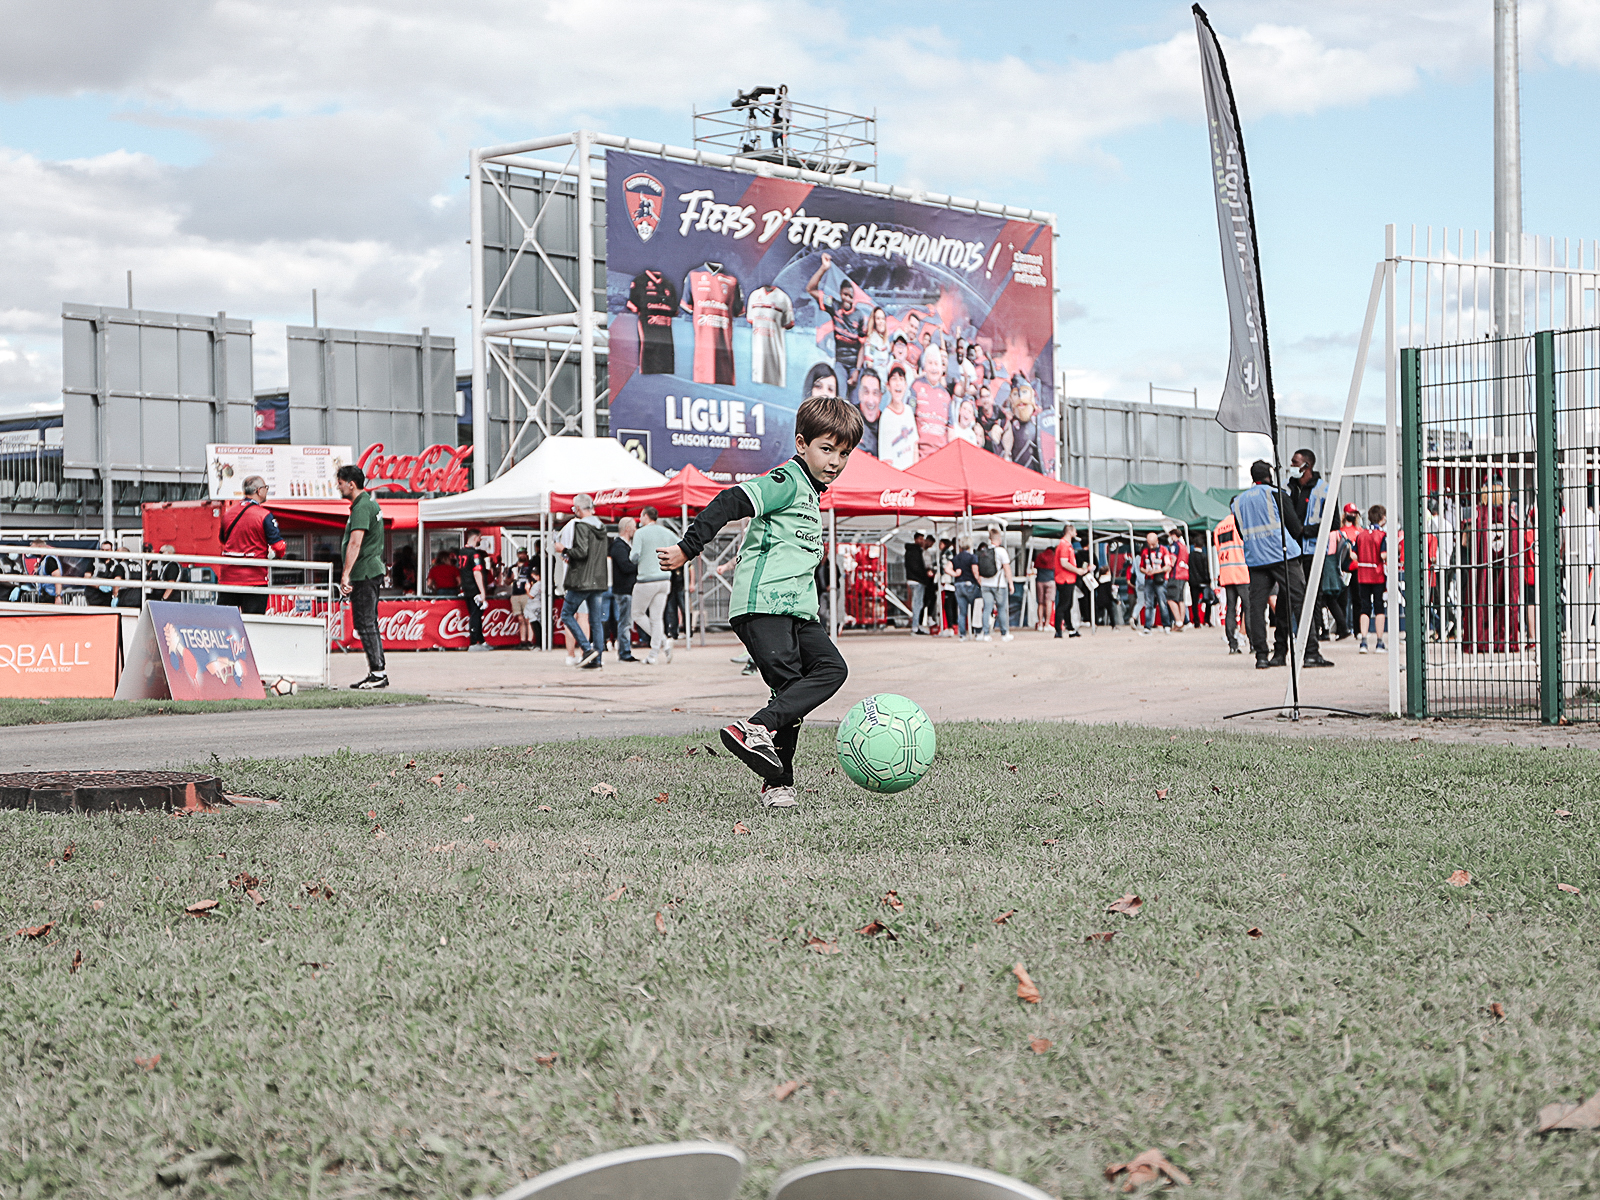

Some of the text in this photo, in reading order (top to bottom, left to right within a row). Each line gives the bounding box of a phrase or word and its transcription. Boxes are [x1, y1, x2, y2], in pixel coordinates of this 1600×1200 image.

[666, 395, 765, 435] LIGUE 1
[671, 433, 761, 450] SAISON 2021 2022
[356, 442, 474, 493] Coca-Cola
[180, 629, 228, 653] TEQBALL
